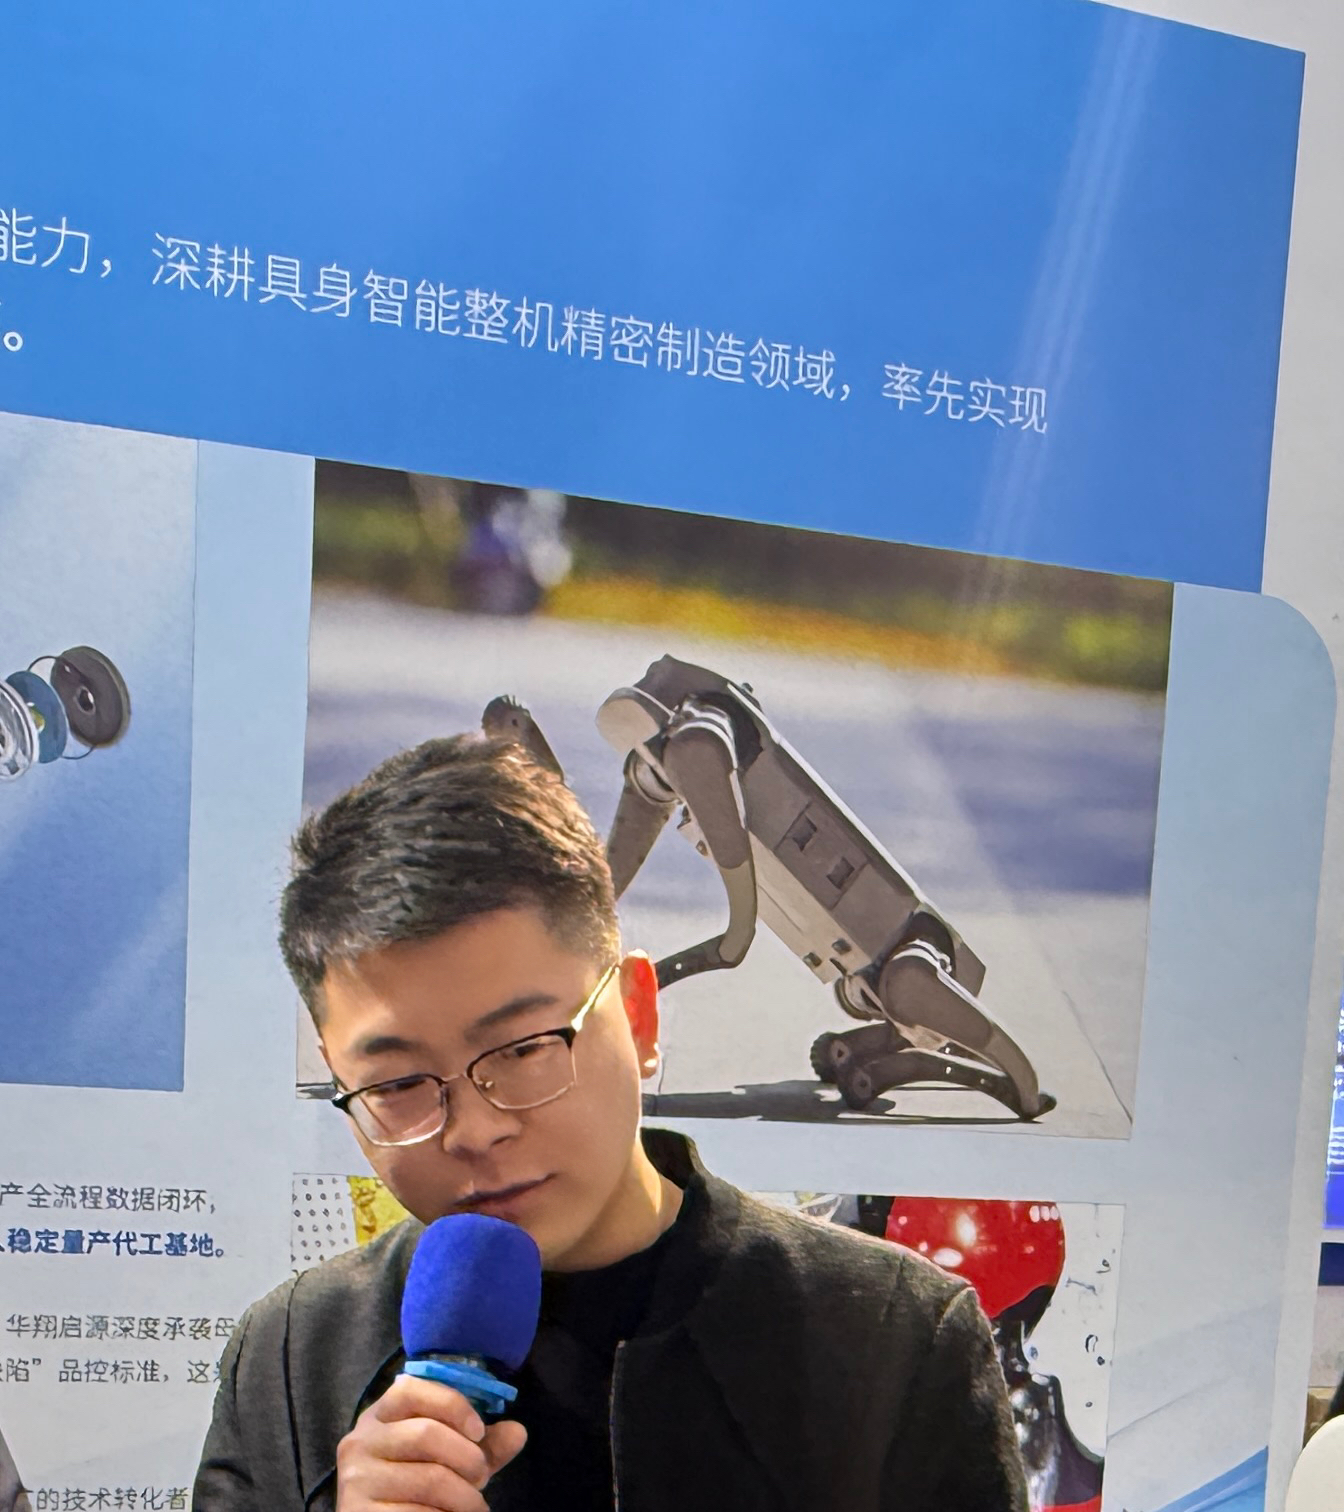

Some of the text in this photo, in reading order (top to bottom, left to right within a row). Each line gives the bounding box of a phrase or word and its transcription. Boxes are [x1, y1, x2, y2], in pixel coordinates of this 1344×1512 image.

[25, 1485, 190, 1512] 的技术转化者
